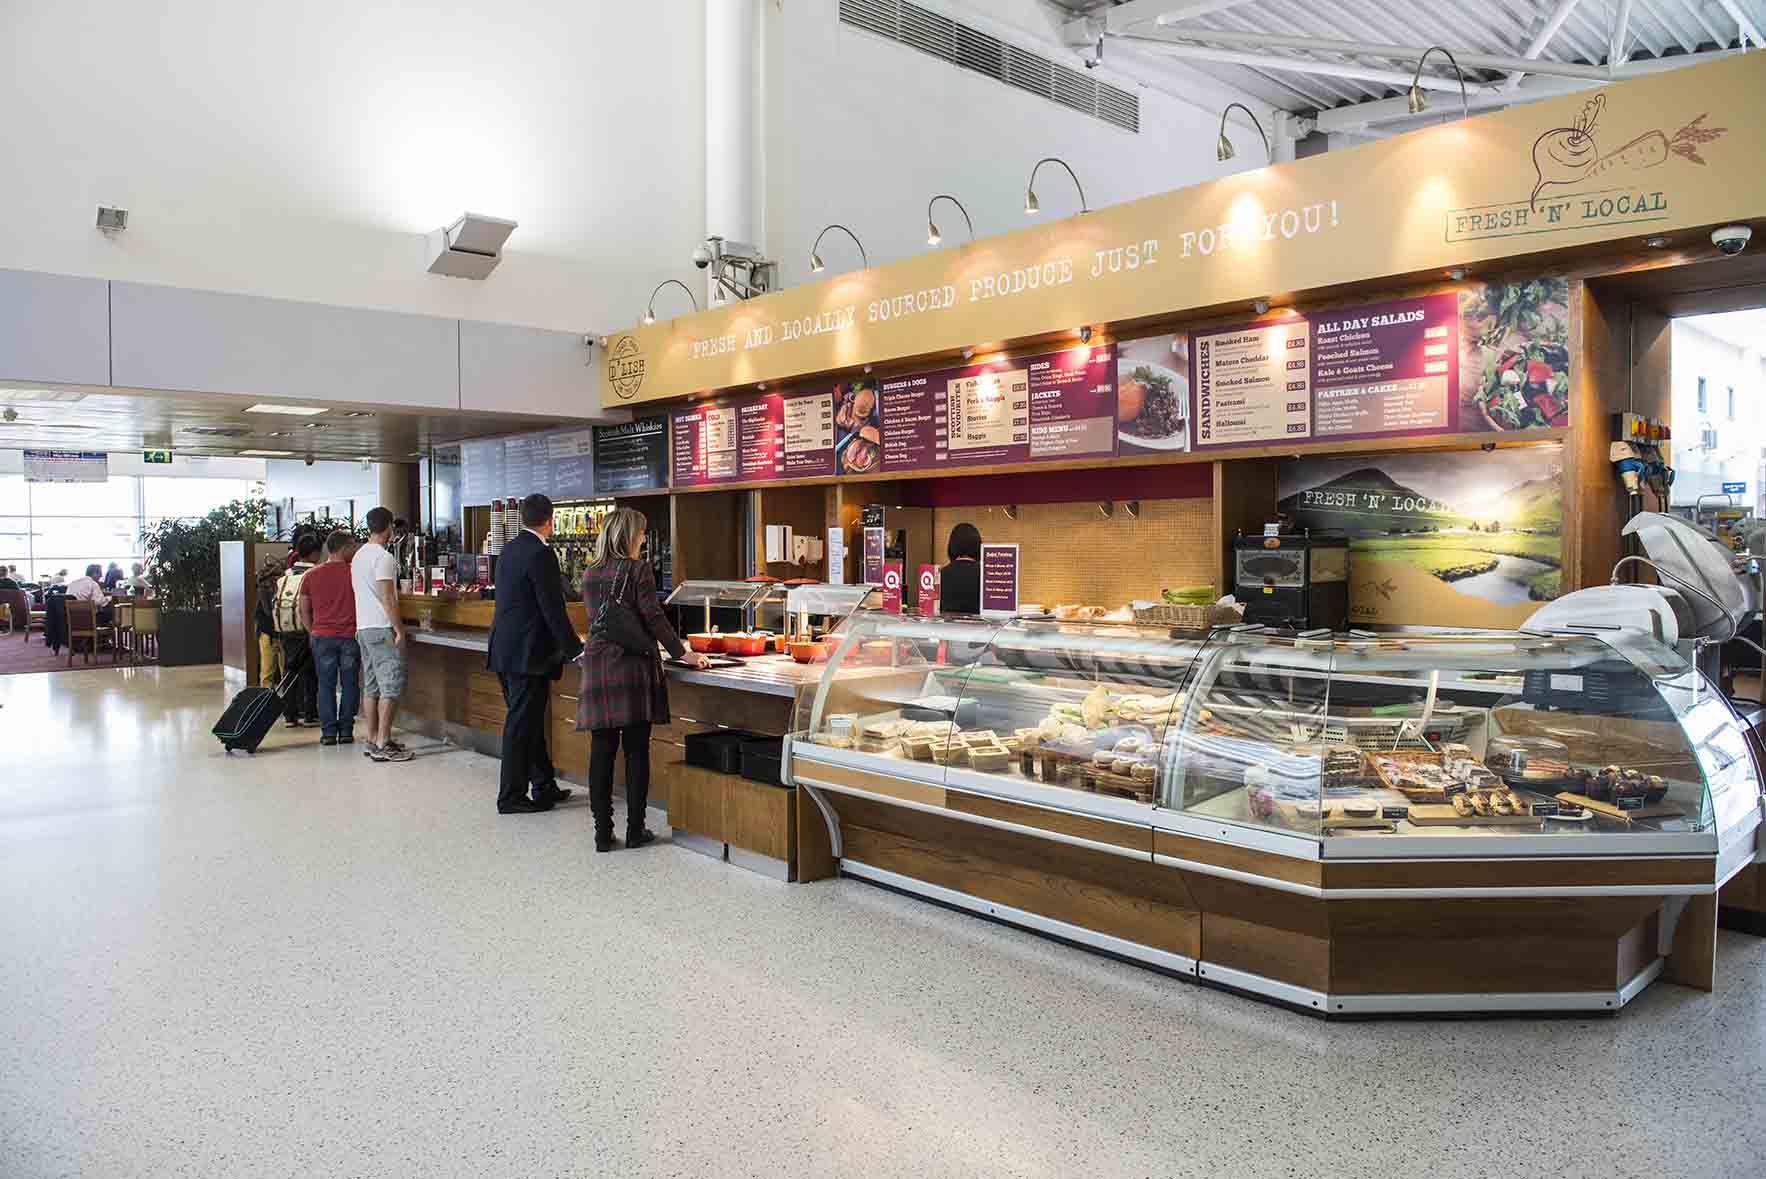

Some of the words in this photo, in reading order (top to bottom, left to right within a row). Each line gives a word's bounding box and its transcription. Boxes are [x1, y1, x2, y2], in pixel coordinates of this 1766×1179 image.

[1455, 208, 1529, 235] FRESH
[1582, 192, 1668, 219] LOCAL
[692, 336, 736, 358] FRESH
[744, 326, 773, 349] AND
[782, 306, 855, 340] LOCALLY
[868, 286, 955, 322] SOURCED
[969, 259, 1072, 301] PRODUCE
[1090, 240, 1159, 277] JUST
[1318, 323, 1341, 334] ALL
[1343, 318, 1369, 330] DAY
[1371, 310, 1425, 327] SALADS
[610, 360, 645, 379] D'LISH
[1200, 341, 1210, 440] SANDWICHES
[1216, 378, 1243, 387] Smoked
[1304, 490, 1357, 508] FRESH
[1391, 496, 1455, 513] LOCA
